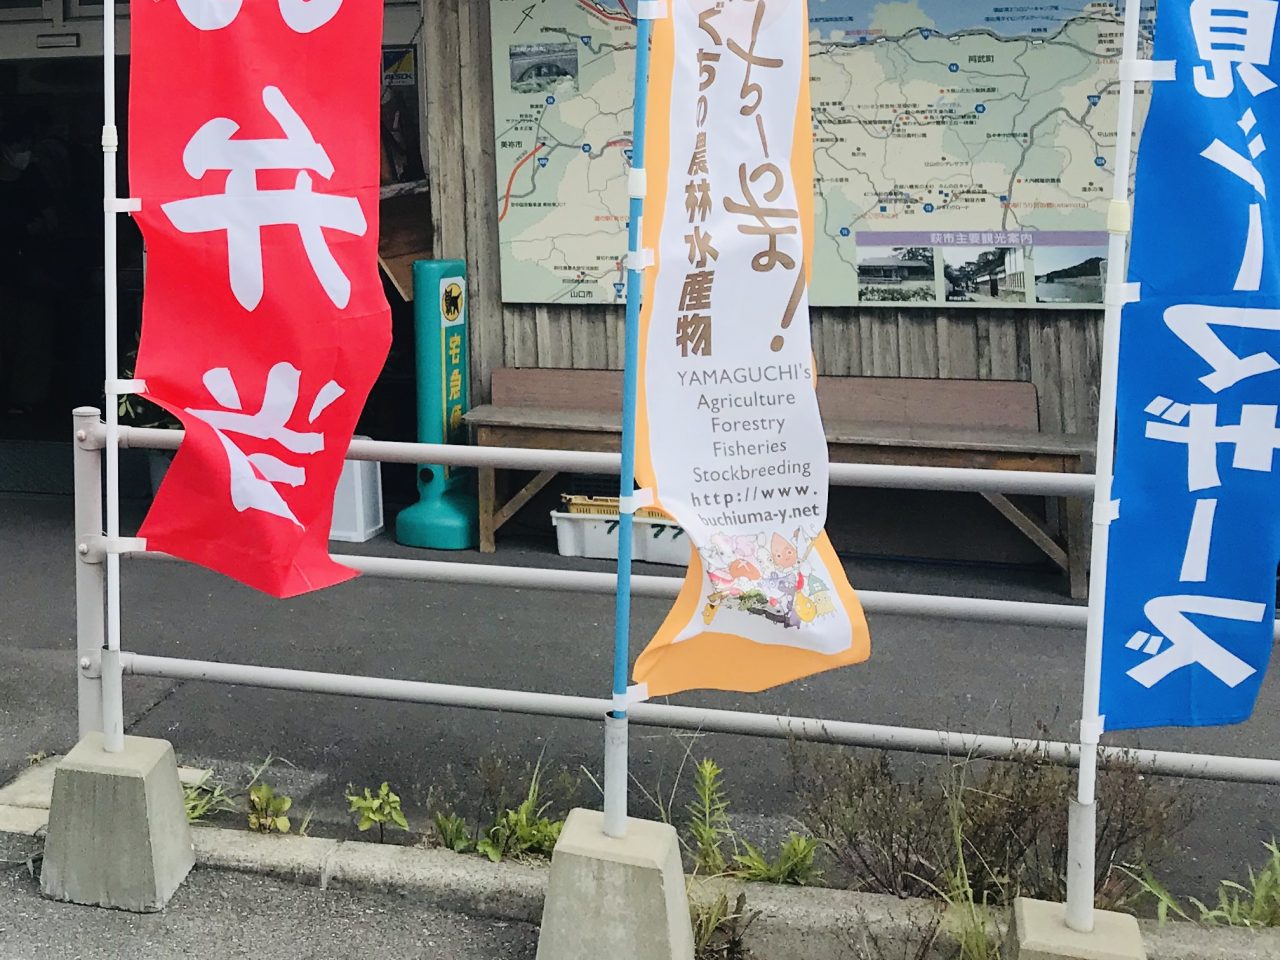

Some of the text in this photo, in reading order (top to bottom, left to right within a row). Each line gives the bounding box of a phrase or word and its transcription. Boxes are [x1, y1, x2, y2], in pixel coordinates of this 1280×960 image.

[968, 55, 995, 64] 阿武町
[930, 232, 1033, 245] 萩市主要観光案内
[677, 363, 812, 387] YAMAGUCHI's
[696, 391, 797, 414] Agriculture
[711, 417, 786, 434] Forestry
[713, 440, 787, 458] Fisheries
[692, 459, 812, 483] Stockbreeding
[690, 484, 819, 508] http://www.
[697, 503, 820, 527] buchiuma-y.net
